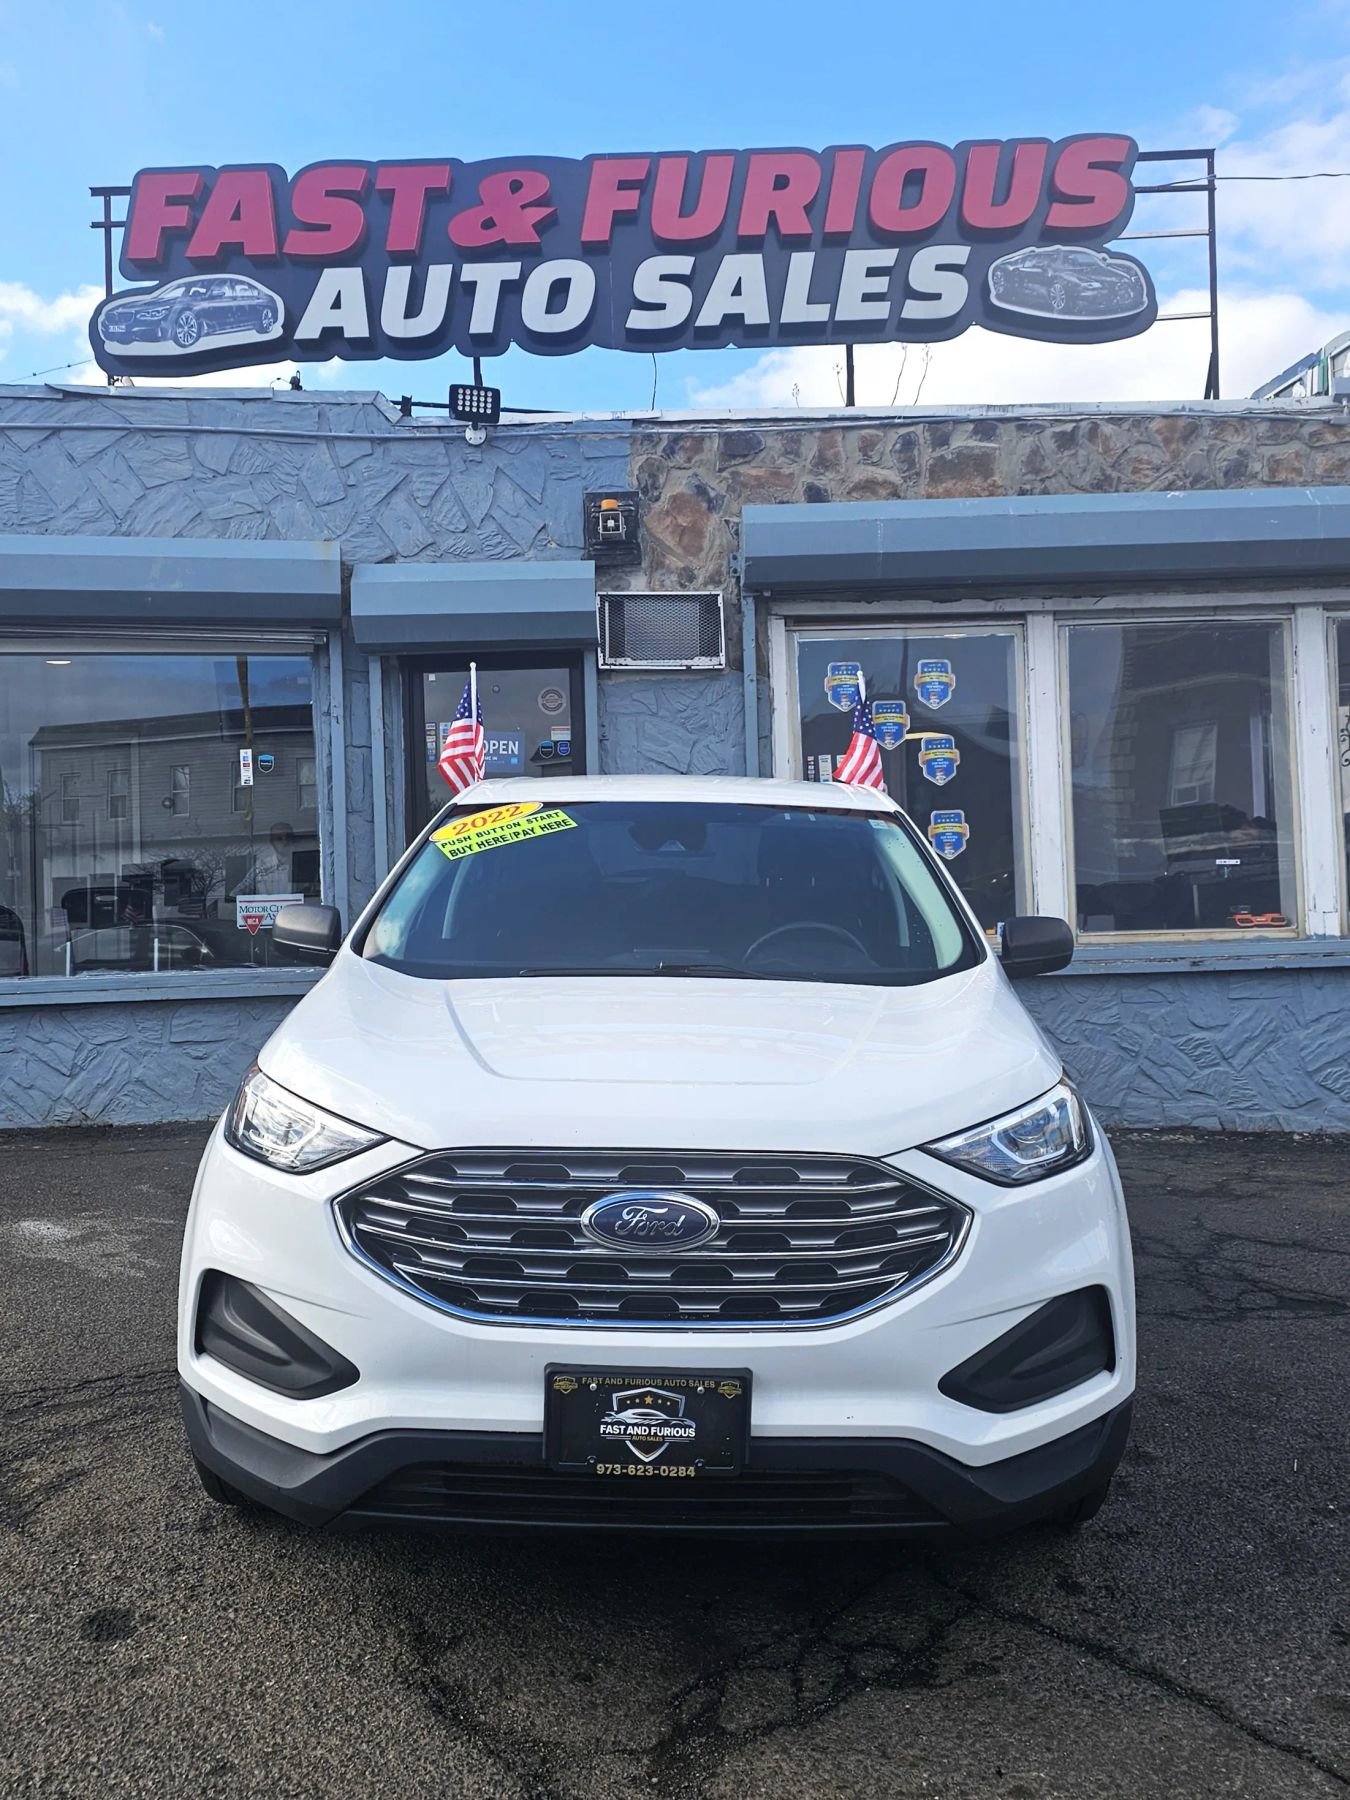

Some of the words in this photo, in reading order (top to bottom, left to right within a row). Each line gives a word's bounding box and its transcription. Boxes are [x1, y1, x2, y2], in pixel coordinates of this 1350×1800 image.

[126, 163, 454, 264] FAST
[447, 169, 559, 250] &
[579, 136, 1132, 246] FURIOUS
[293, 257, 597, 341] AUTO
[624, 244, 972, 331] SALES
[483, 740, 519, 754] OPEN
[440, 835, 471, 849] PUSH
[475, 821, 521, 838] BUTTON
[526, 811, 560, 825] START
[452, 805, 524, 836] 2022
[448, 844, 474, 858] BUY
[475, 826, 538, 850] HERE/PAY
[538, 818, 573, 833] HERE
[614, 1205, 686, 1236] Ford
[582, 1376, 603, 1385] FAST
[604, 1377, 623, 1385] AND
[624, 1377, 662, 1387] FURIOUS
[663, 1378, 687, 1387] AUTO
[688, 1379, 716, 1389] SALES
[599, 1424, 626, 1435] FAST
[626, 1425, 649, 1435] AND
[650, 1426, 696, 1438] FURIOUS
[596, 1463, 696, 1478] 973-623-0284
